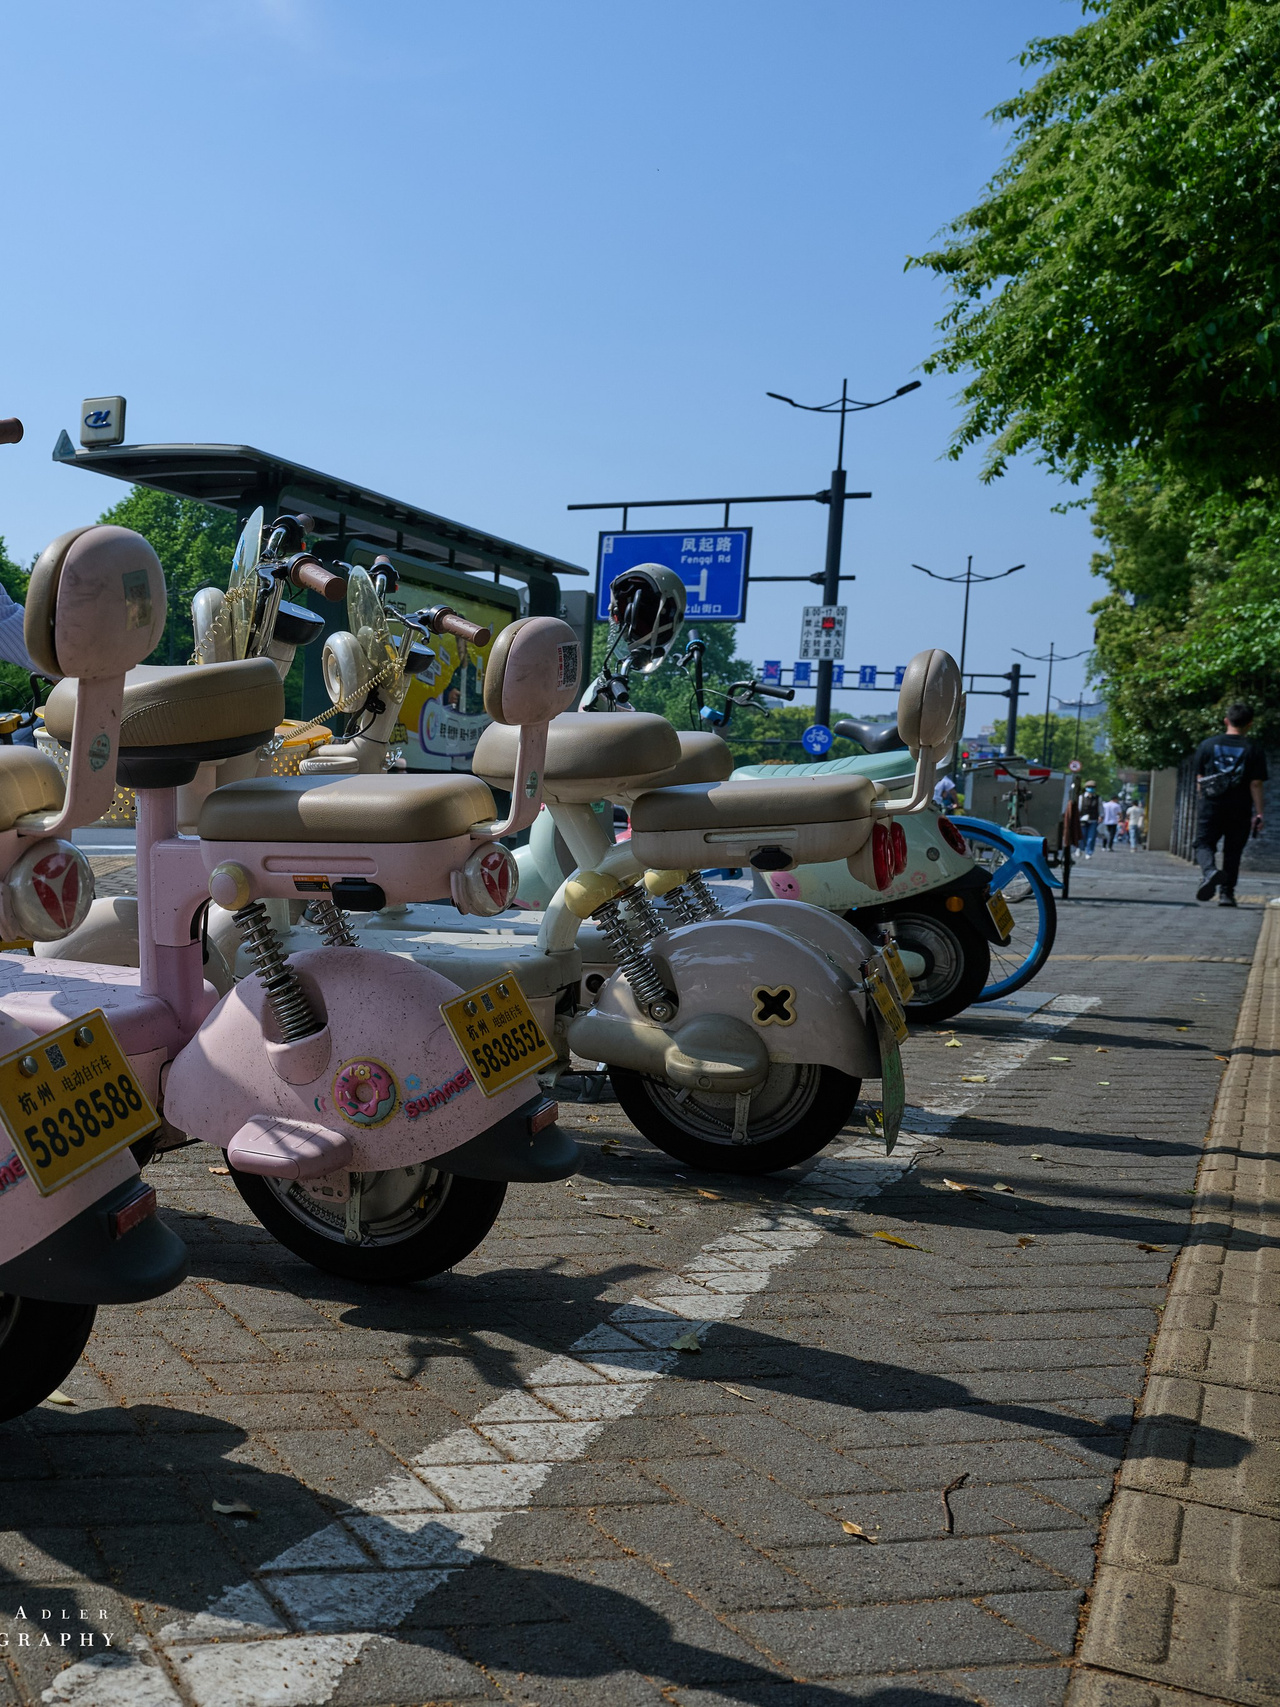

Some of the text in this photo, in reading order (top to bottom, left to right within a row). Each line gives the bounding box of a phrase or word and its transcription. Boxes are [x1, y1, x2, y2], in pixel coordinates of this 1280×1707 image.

[680, 554, 731, 566] Fengqi Rd
[681, 536, 732, 553] 凤起路
[466, 1018, 490, 1042] 杭州
[472, 1019, 546, 1079] 5838552
[18, 1054, 112, 1117] 杭州 电动自行车
[24, 1074, 142, 1169] 5838588
